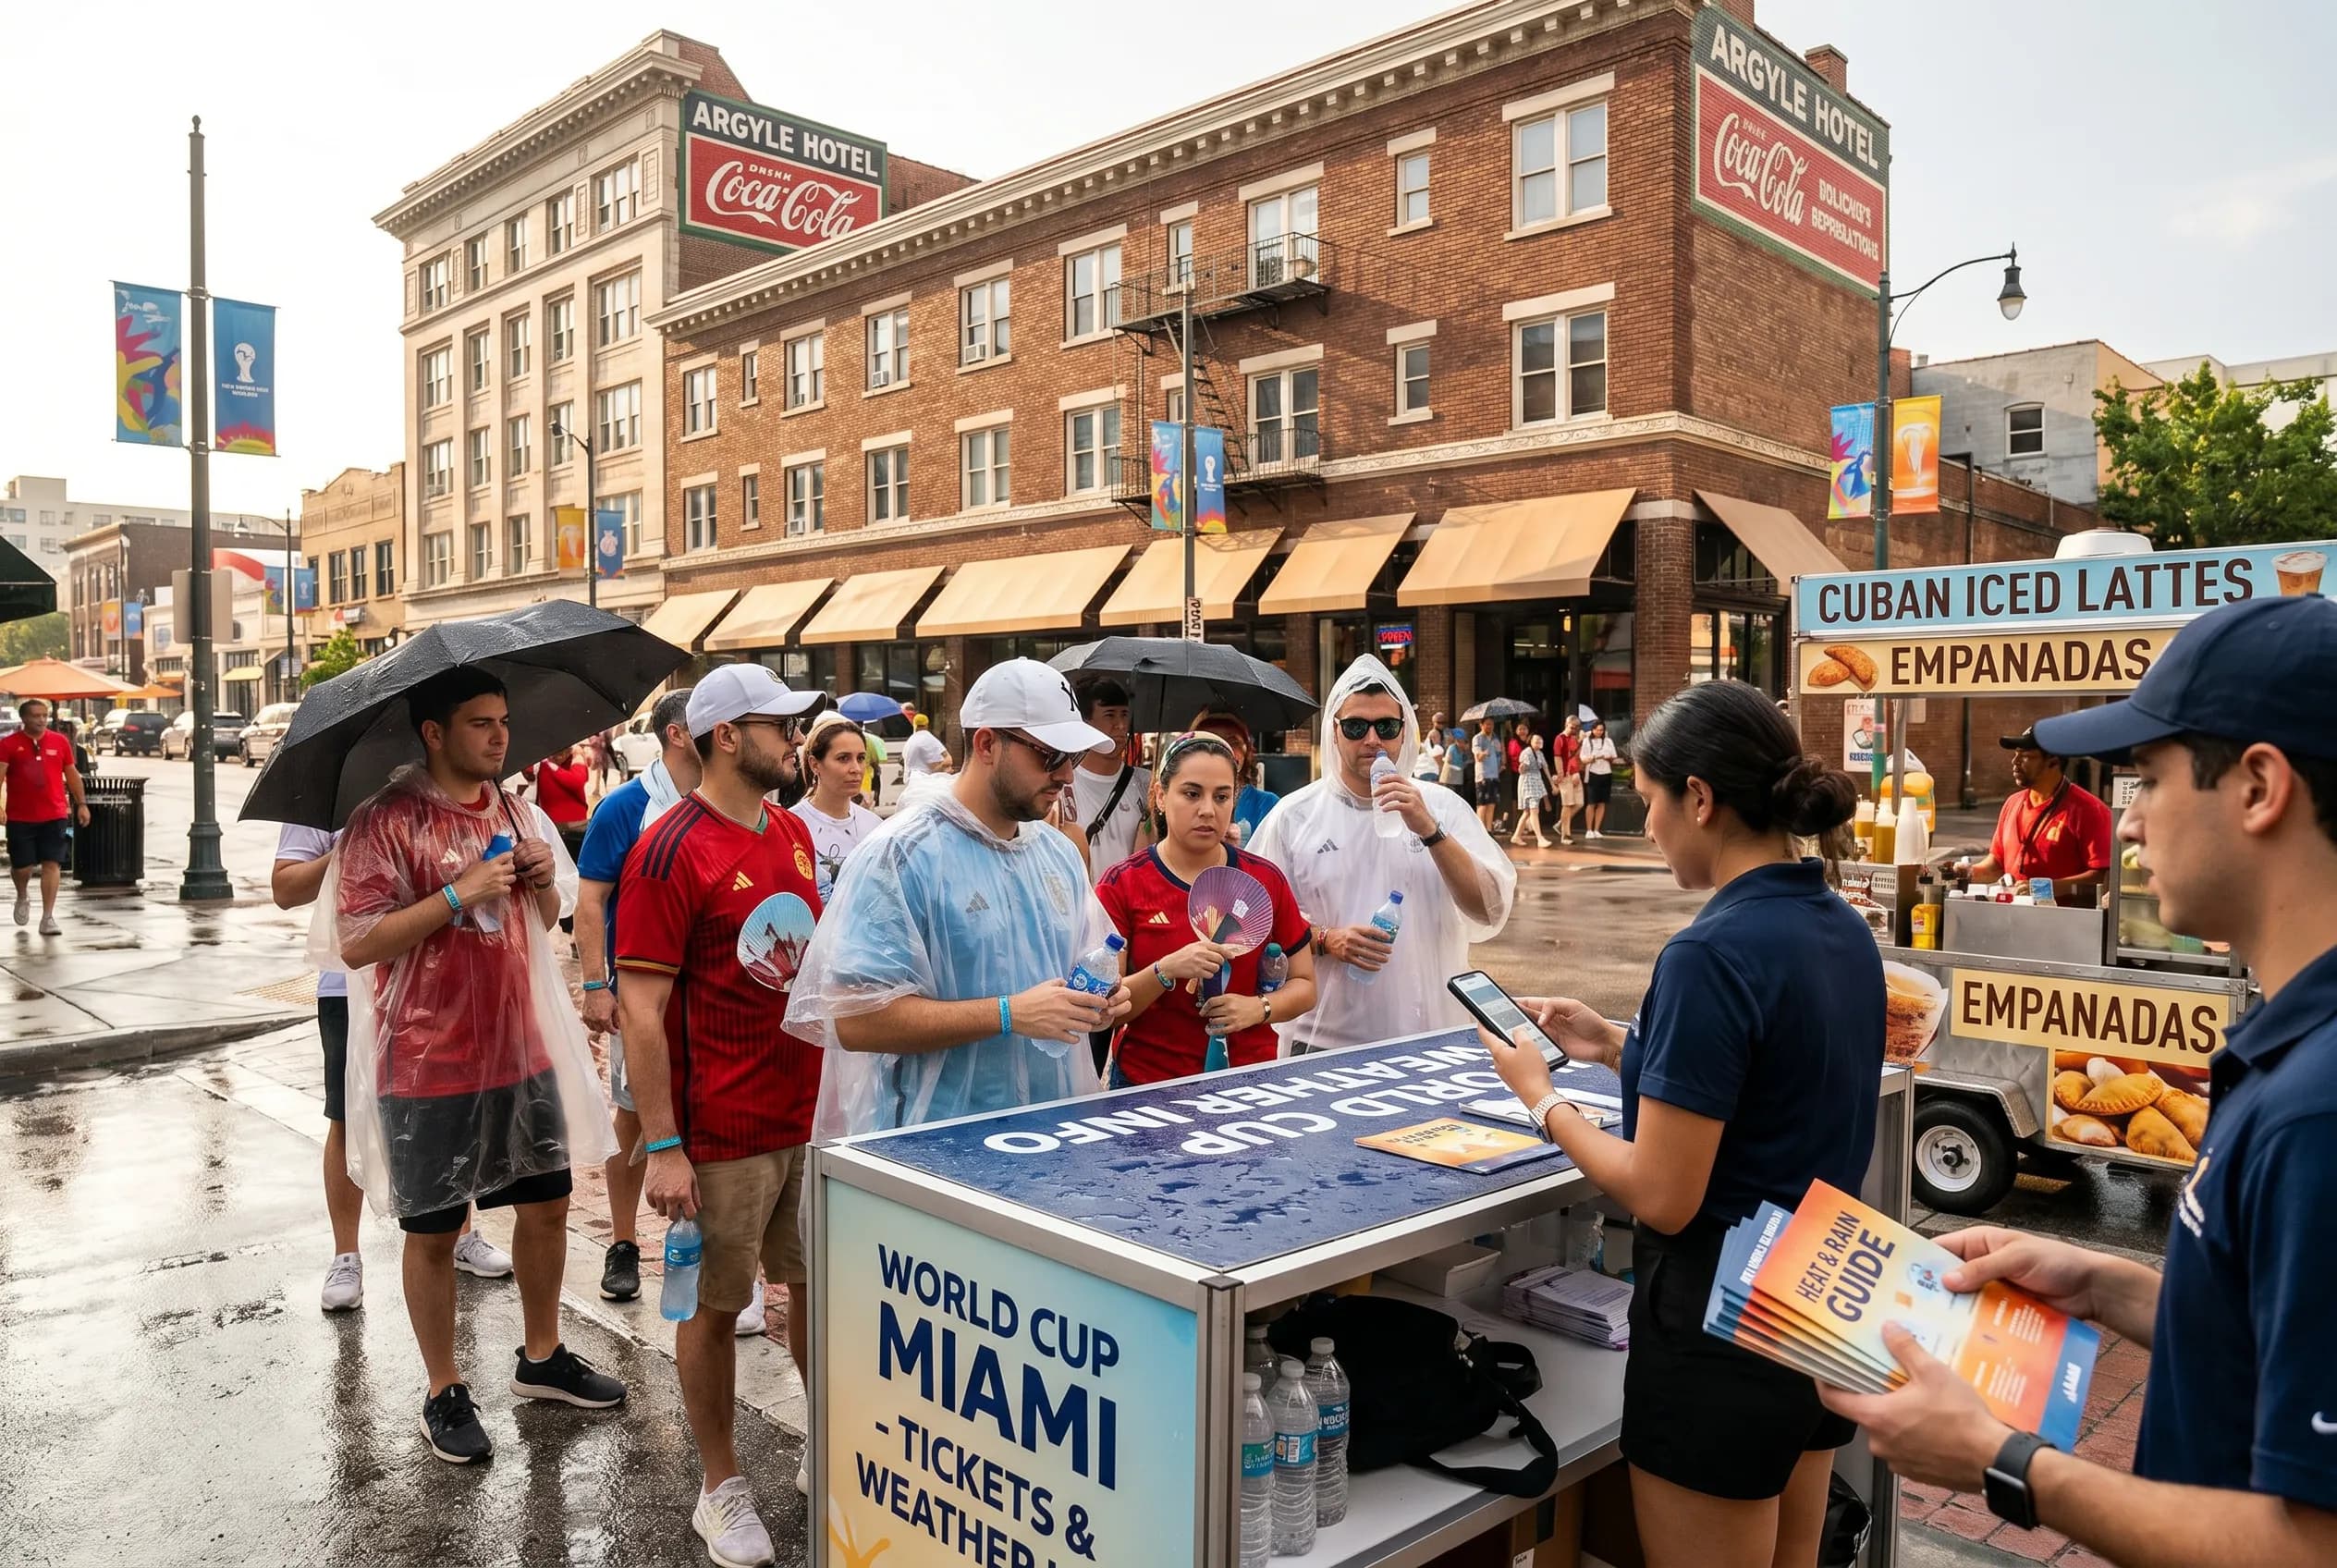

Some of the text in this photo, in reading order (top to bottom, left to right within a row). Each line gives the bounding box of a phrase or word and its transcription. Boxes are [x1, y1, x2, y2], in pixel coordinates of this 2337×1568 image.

[692, 101, 878, 178] ARGYLE HOTEL
[1710, 23, 1879, 171] ARGYLE HOTEL
[705, 160, 863, 239] Coca-Cola
[1713, 112, 1811, 227] Coca-Cola
[1818, 557, 2254, 625] CUBAN ICED LATTES
[1891, 638, 2152, 685] EMPANADAS
[1962, 981, 2218, 1054] EMPANADAS
[983, 1046, 1494, 1154] WEATHER INFO
[1181, 1112, 1337, 1156] CUP
[1795, 1210, 1861, 1304] HEAT & RAIN
[1827, 1228, 1896, 1322] GUIDE
[877, 1243, 1119, 1378] WORLD CUP
[879, 1300, 1117, 1491] MIAMI
[898, 1415, 1054, 1537] TICKETS
[1065, 1504, 1097, 1562] &
